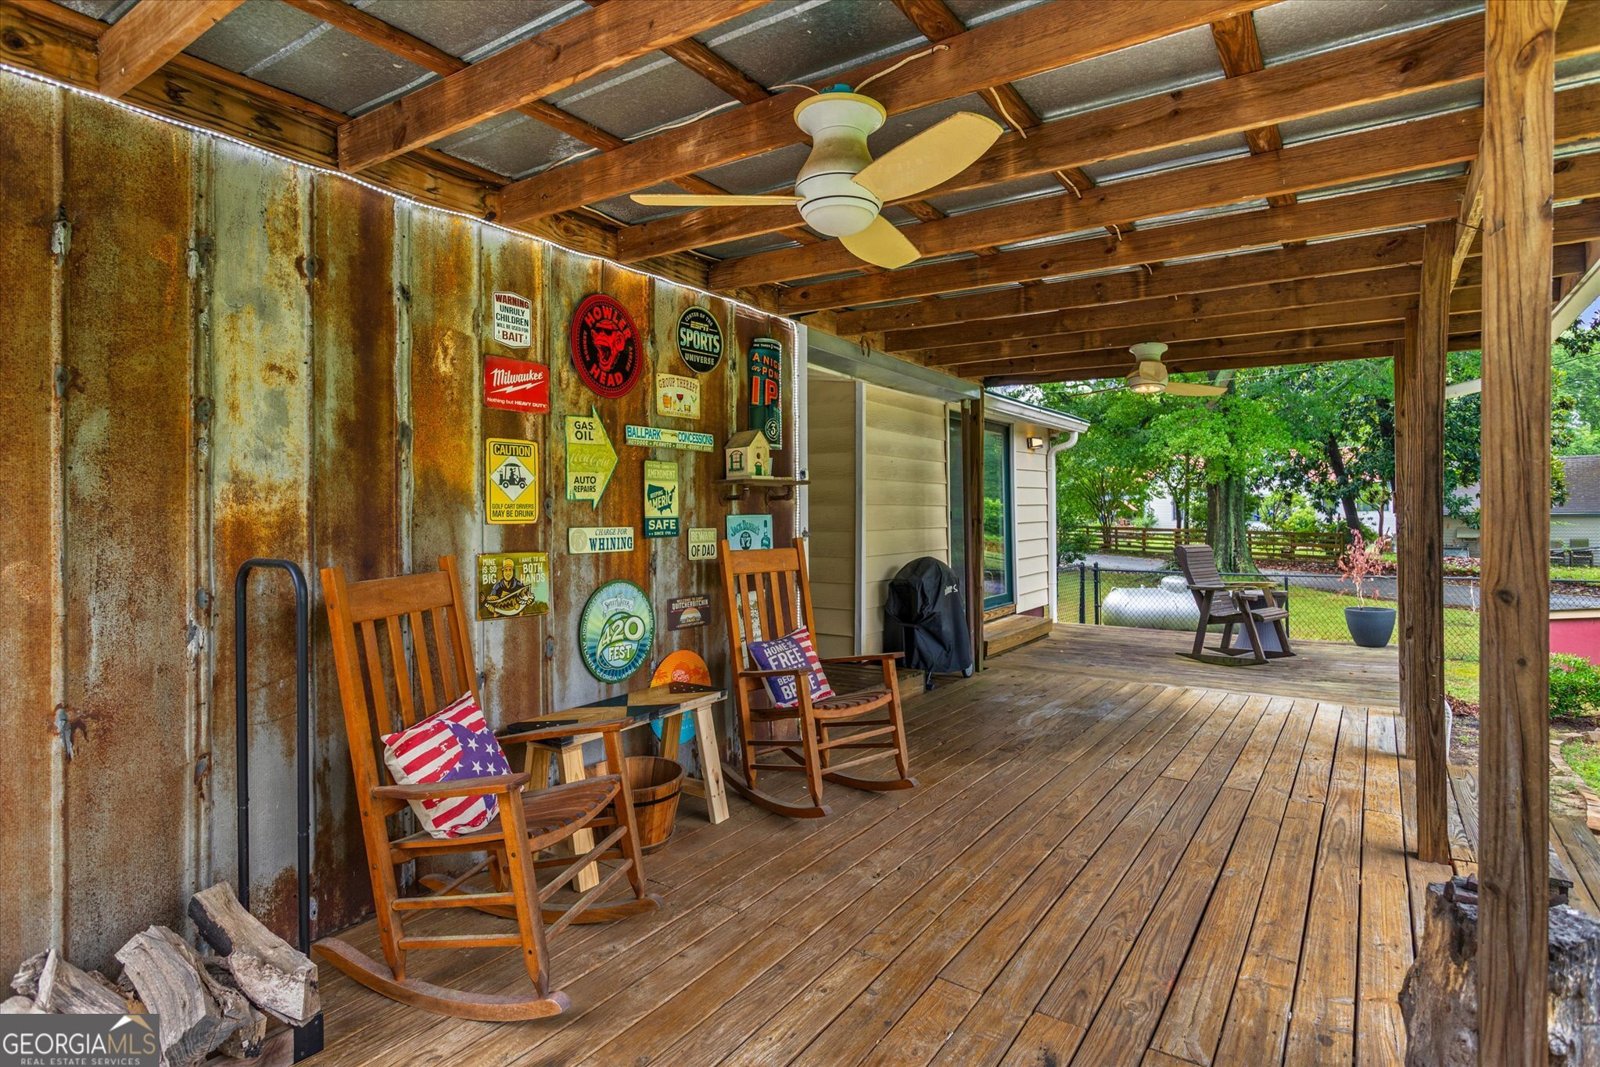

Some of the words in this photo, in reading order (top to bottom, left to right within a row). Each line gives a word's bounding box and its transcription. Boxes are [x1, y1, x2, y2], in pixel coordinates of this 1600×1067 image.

[495, 294, 529, 309] WARNING
[500, 305, 525, 316] UNRULY
[685, 312, 699, 322] CENTER
[496, 313, 529, 327] CHILDREN
[585, 305, 632, 340] HOWLER
[690, 321, 709, 331] ESPN
[502, 330, 524, 343] BAIT
[680, 327, 720, 353] SPORTS
[684, 353, 715, 365] UNIVERSE
[752, 352, 760, 362] A
[763, 355, 781, 370] NIG
[490, 368, 543, 386] Milwaukee
[590, 363, 623, 386] HEAD
[762, 366, 780, 380] PON
[659, 377, 675, 388] GROUP
[676, 377, 698, 393] THERAPY
[752, 375, 780, 405] IP
[575, 431, 594, 441] OIL
[627, 427, 661, 440] BALLPARK
[678, 432, 713, 445] CONCESSIONS
[494, 444, 531, 457] CAUTION
[574, 476, 596, 484] AUTO
[648, 469, 676, 480] AMENDMENT
[574, 485, 596, 493] REPAIRS
[648, 519, 676, 530] SAFE
[595, 528, 616, 536] CHARGE
[691, 531, 716, 541] BEWARE
[589, 537, 632, 551] WHINING
[691, 545, 700, 557] OF
[702, 544, 716, 556] DAD
[482, 558, 496, 566] MINE
[522, 563, 543, 574] BOTH
[490, 565, 497, 573] SO
[482, 573, 497, 585] BIG
[520, 573, 546, 584] HANDS
[601, 616, 645, 646] 420
[608, 645, 632, 661] FEST
[764, 643, 788, 657] HOME
[768, 648, 804, 670] FREE
